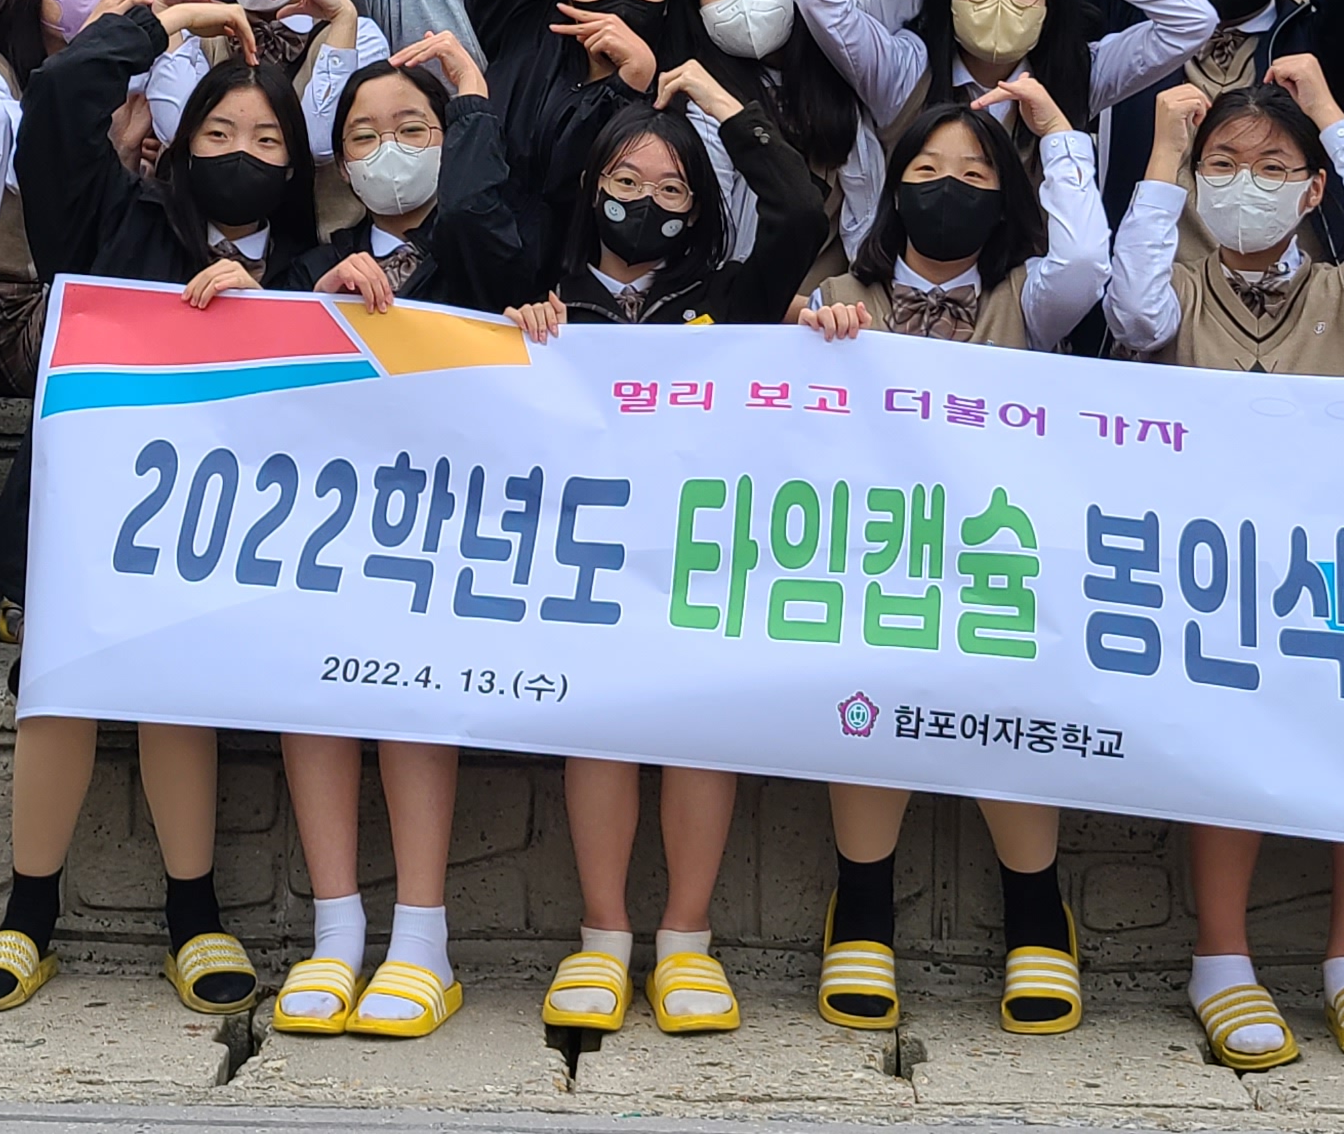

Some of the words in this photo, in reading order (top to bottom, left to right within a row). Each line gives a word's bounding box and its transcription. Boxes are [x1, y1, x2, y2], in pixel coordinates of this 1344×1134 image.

[612, 382, 714, 413] 멀리
[746, 382, 851, 414] 보고
[884, 388, 1047, 436] 더불어
[1079, 412, 1189, 452] 가자
[112, 438, 632, 626] 2022학년도
[669, 474, 1041, 660] 타임캡슐
[320, 656, 442, 690] 2022.4.
[459, 668, 569, 703] 13.(수)
[893, 704, 1126, 760] 합포여자중학교
